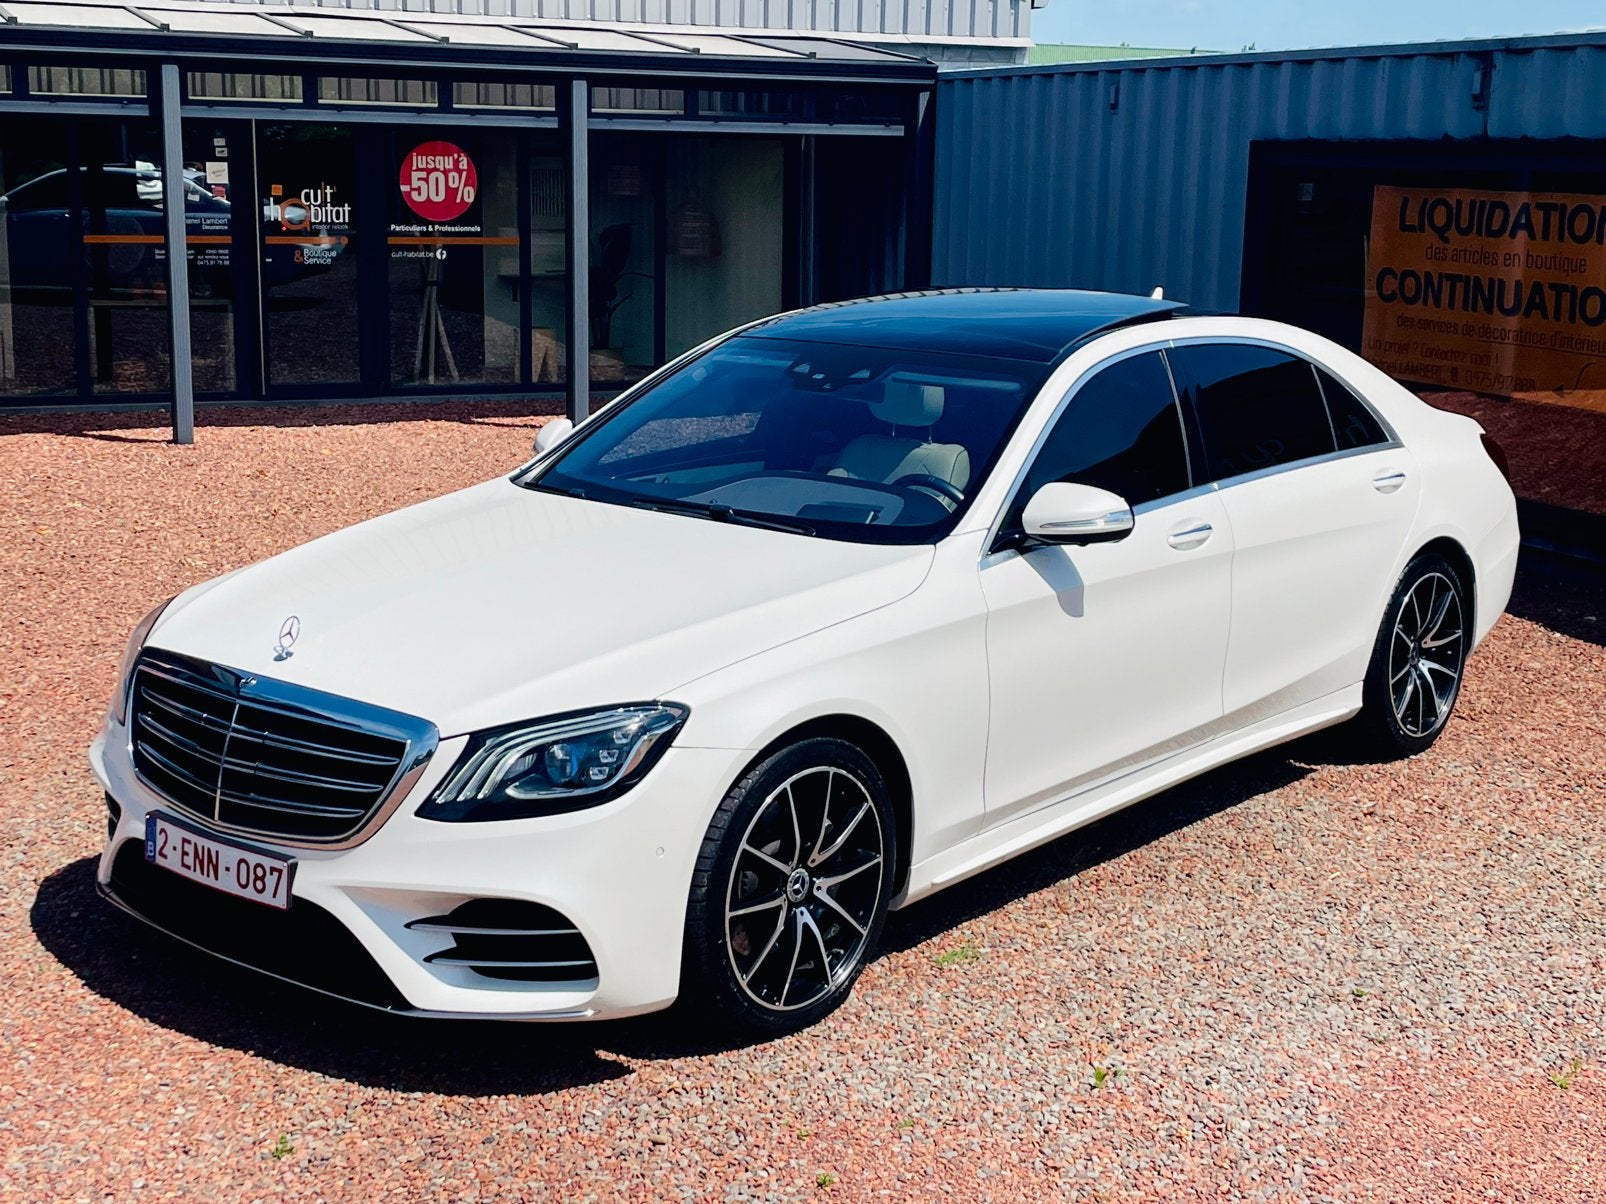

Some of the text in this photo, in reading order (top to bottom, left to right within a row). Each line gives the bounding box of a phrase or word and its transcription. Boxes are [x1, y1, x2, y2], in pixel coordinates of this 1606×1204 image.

[412, 152, 468, 171] jusqu'à
[400, 171, 475, 203] -50%
[390, 224, 427, 232] Particuliers
[303, 248, 337, 258] Boutique
[303, 256, 332, 265] Service
[1425, 242, 1587, 278] des articles en boutique
[1397, 312, 1414, 330] des
[1416, 317, 1458, 336] services
[1461, 321, 1475, 338] de
[147, 841, 155, 857] B
